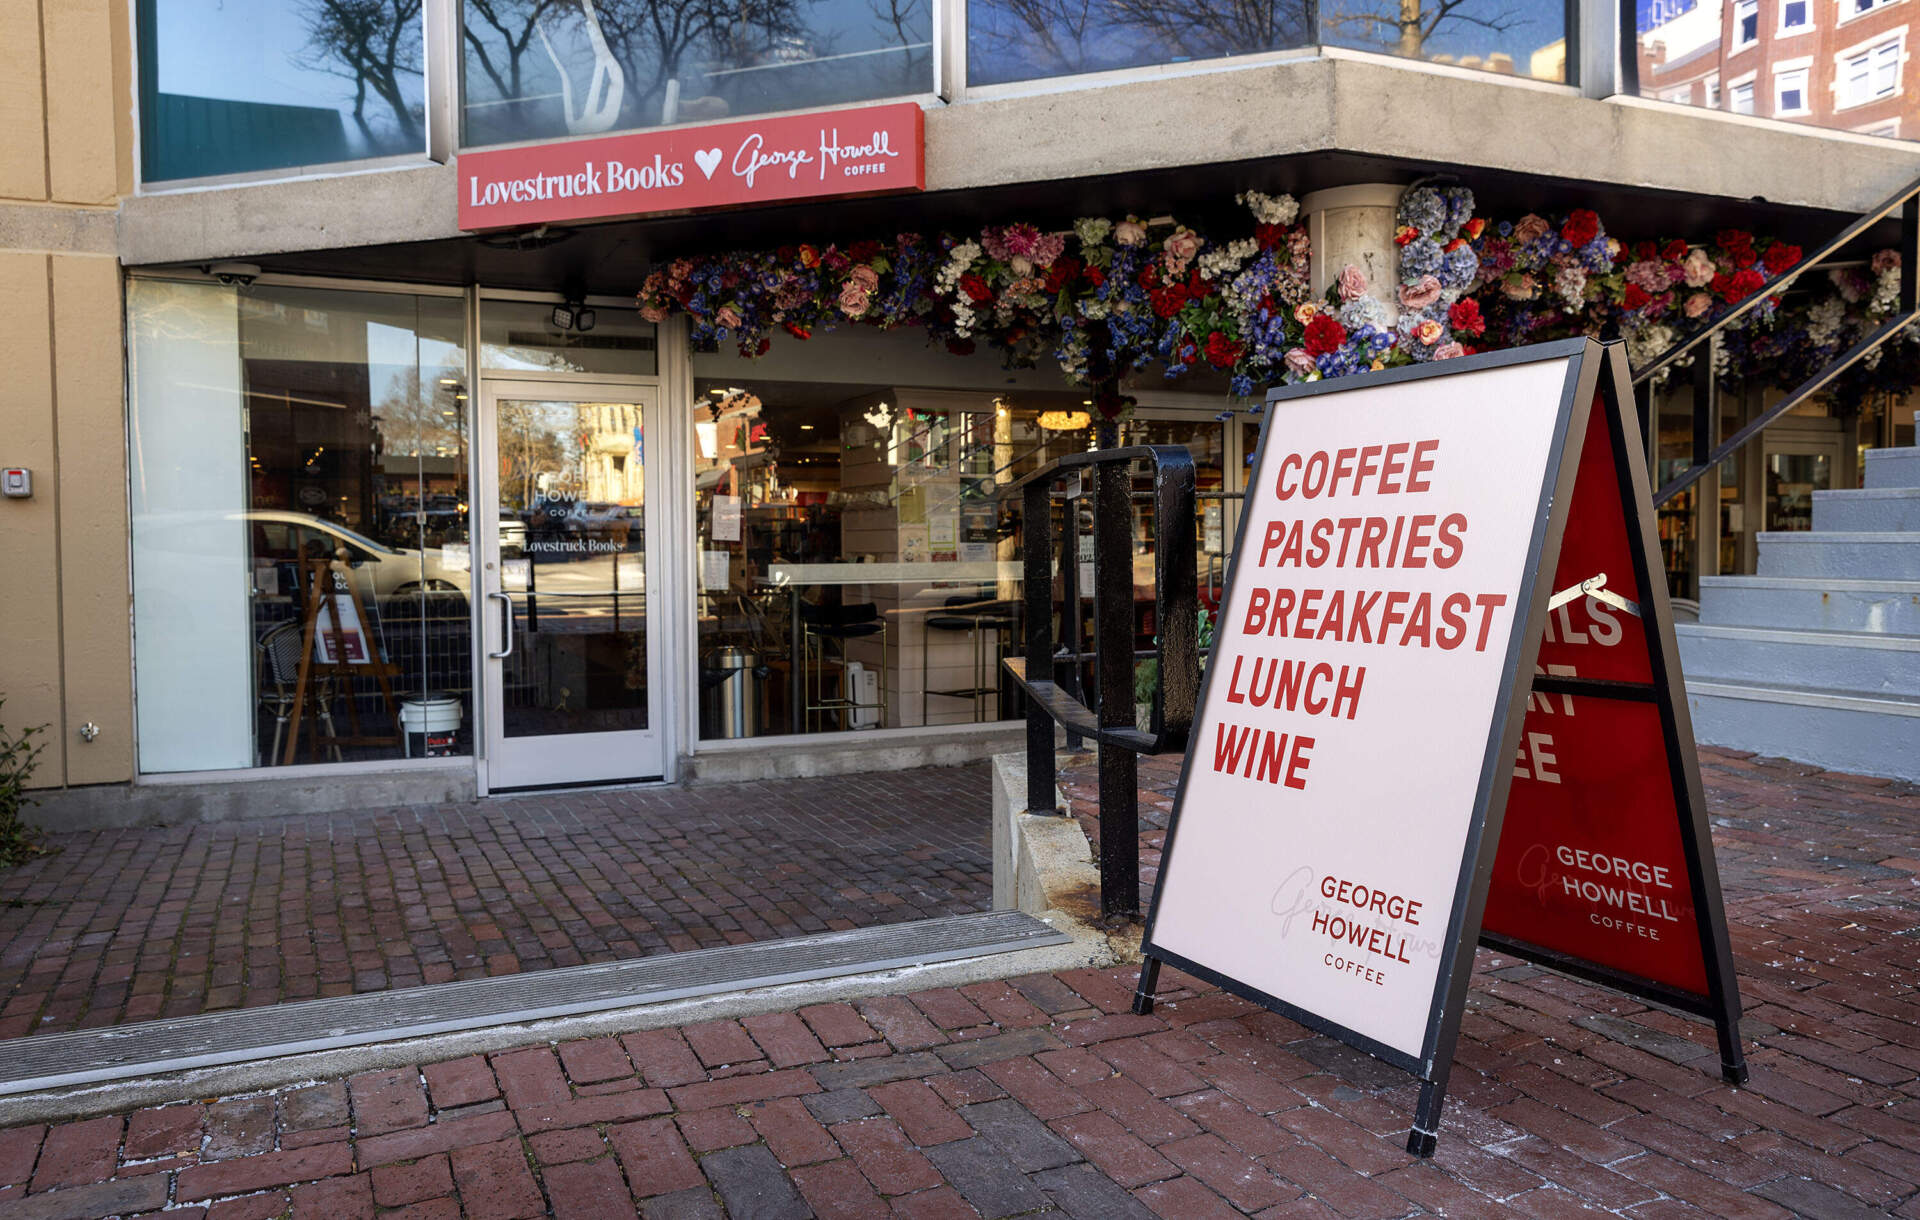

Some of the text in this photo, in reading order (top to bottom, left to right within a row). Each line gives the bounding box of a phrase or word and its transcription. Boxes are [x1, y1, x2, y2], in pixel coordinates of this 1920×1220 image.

[469, 154, 685, 207] Lovestruck Books
[731, 127, 899, 188] George Howell
[843, 163, 886, 177] COFFEE
[534, 489, 592, 503] HOWE
[1275, 439, 1440, 502] COFFEE
[523, 538, 624, 552] Lovestruck Books
[1257, 513, 1468, 570] PASTRIES
[1242, 587, 1508, 653] BREAKFAST
[1226, 655, 1367, 721] LUNCH
[1213, 721, 1316, 791] WINE
[1556, 845, 1673, 889] GEORGE
[1320, 875, 1423, 926] GEORGE
[1562, 876, 1679, 922] HOWELL
[1311, 910, 1411, 965] HOWELL
[1590, 913, 1660, 942] COFFEE
[1324, 953, 1385, 986] COFFEE
